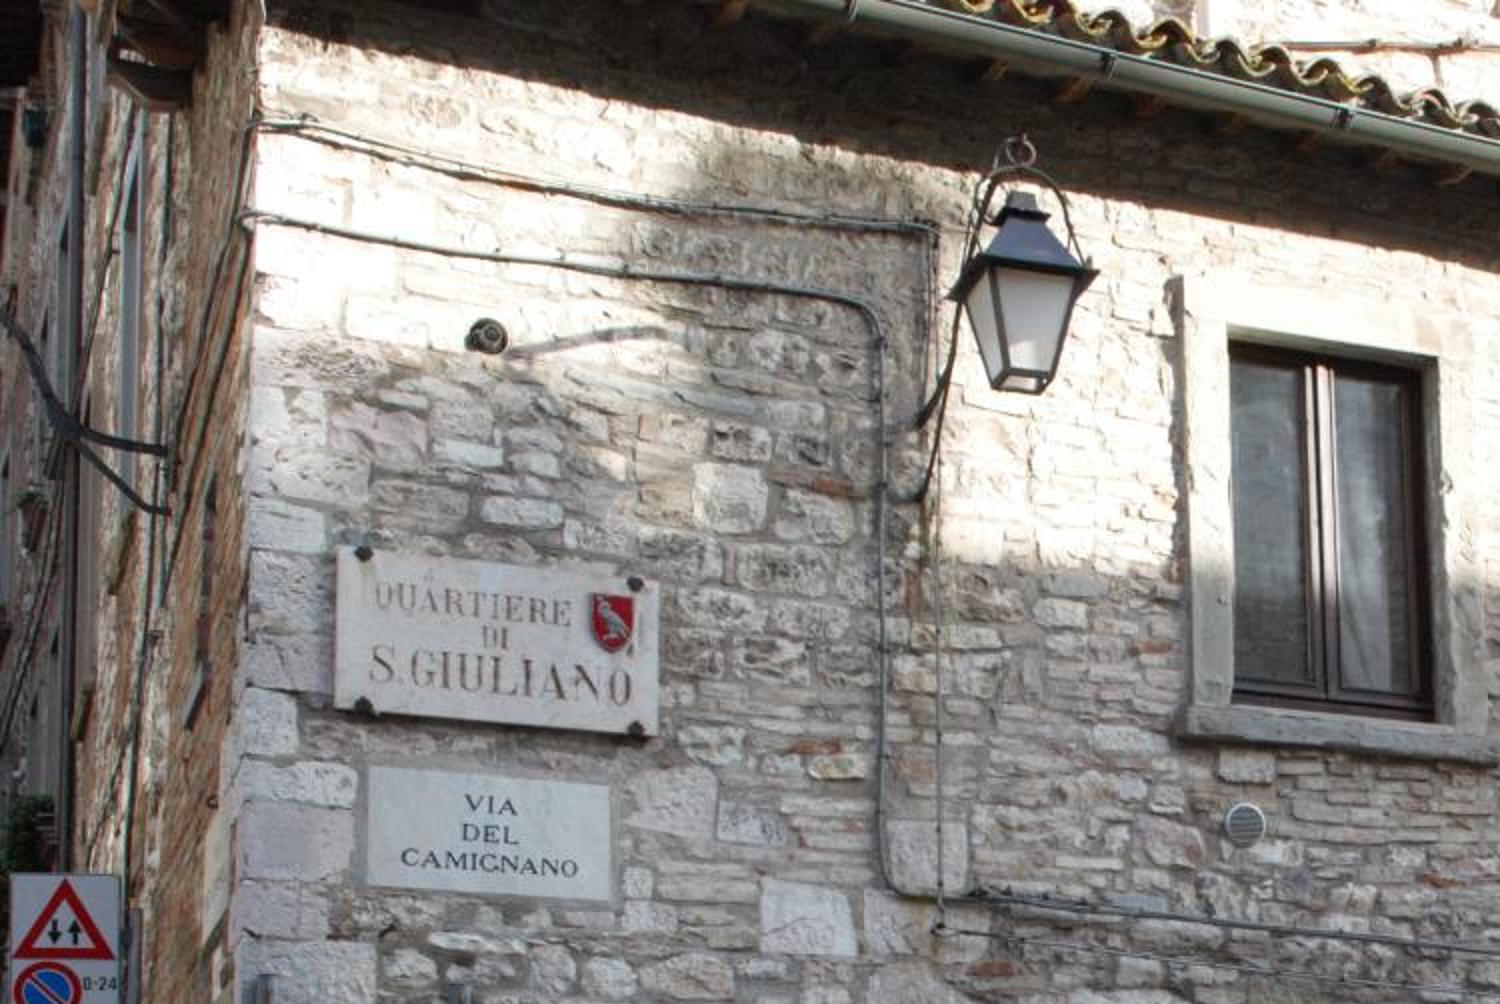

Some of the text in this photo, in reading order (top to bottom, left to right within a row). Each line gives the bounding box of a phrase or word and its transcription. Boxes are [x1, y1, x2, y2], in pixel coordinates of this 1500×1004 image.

[375, 581, 571, 627] QUARTIERE
[482, 625, 509, 649] DI
[464, 793, 518, 816] VIA
[462, 823, 519, 845] DEL
[400, 847, 578, 878] CAMIGNANO
